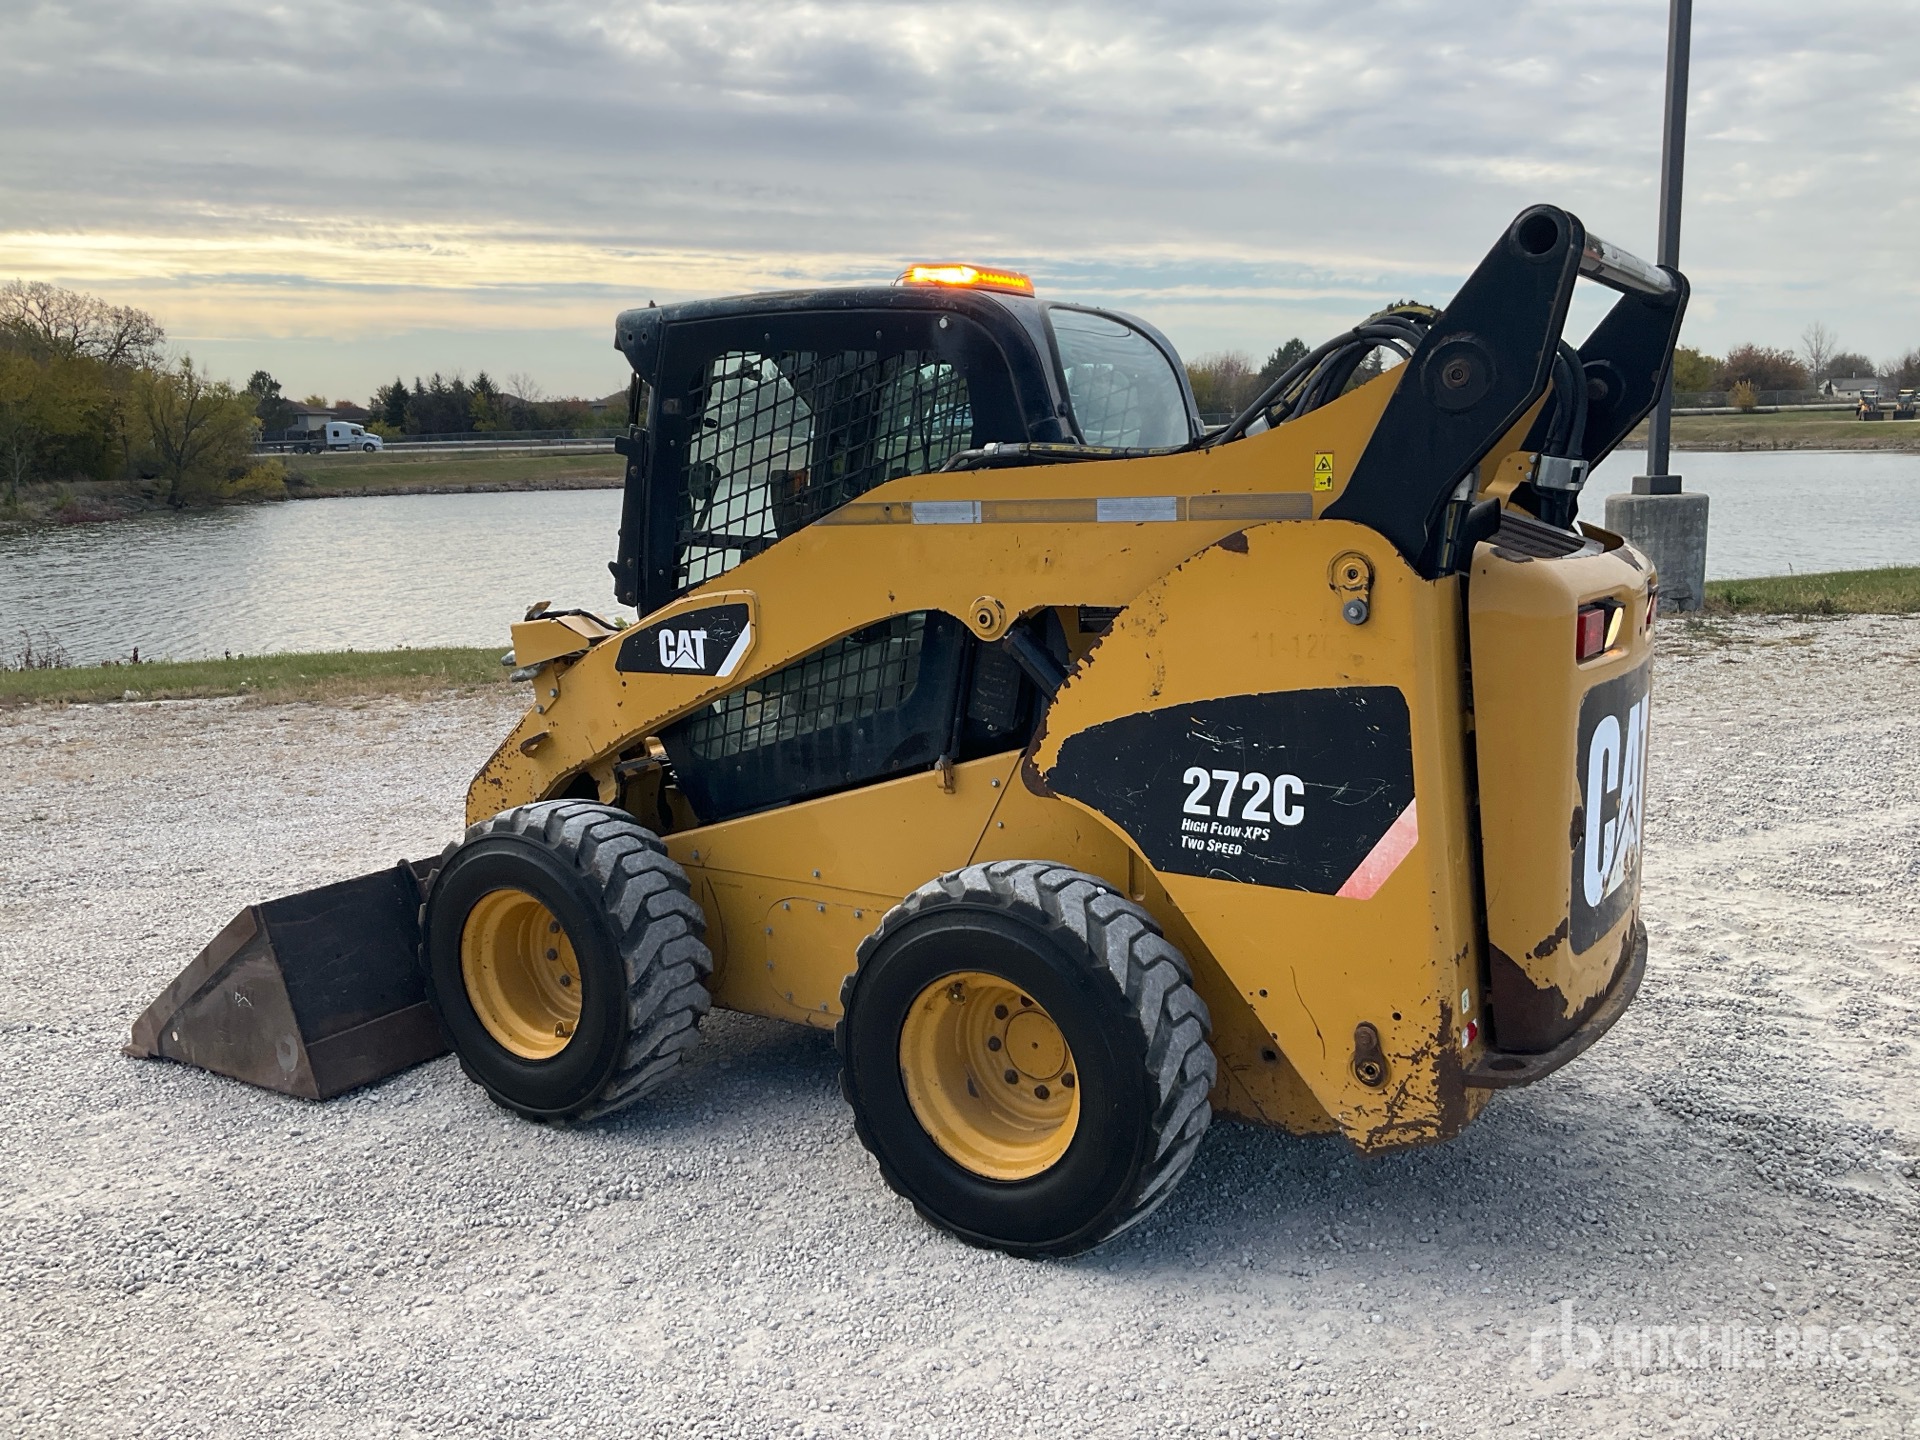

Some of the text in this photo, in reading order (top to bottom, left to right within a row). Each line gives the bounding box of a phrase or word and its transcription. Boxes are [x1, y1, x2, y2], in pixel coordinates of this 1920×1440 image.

[658, 628, 708, 670] CAT
[1182, 766, 1305, 826] 272C
[1243, 826, 1271, 841] XPS
